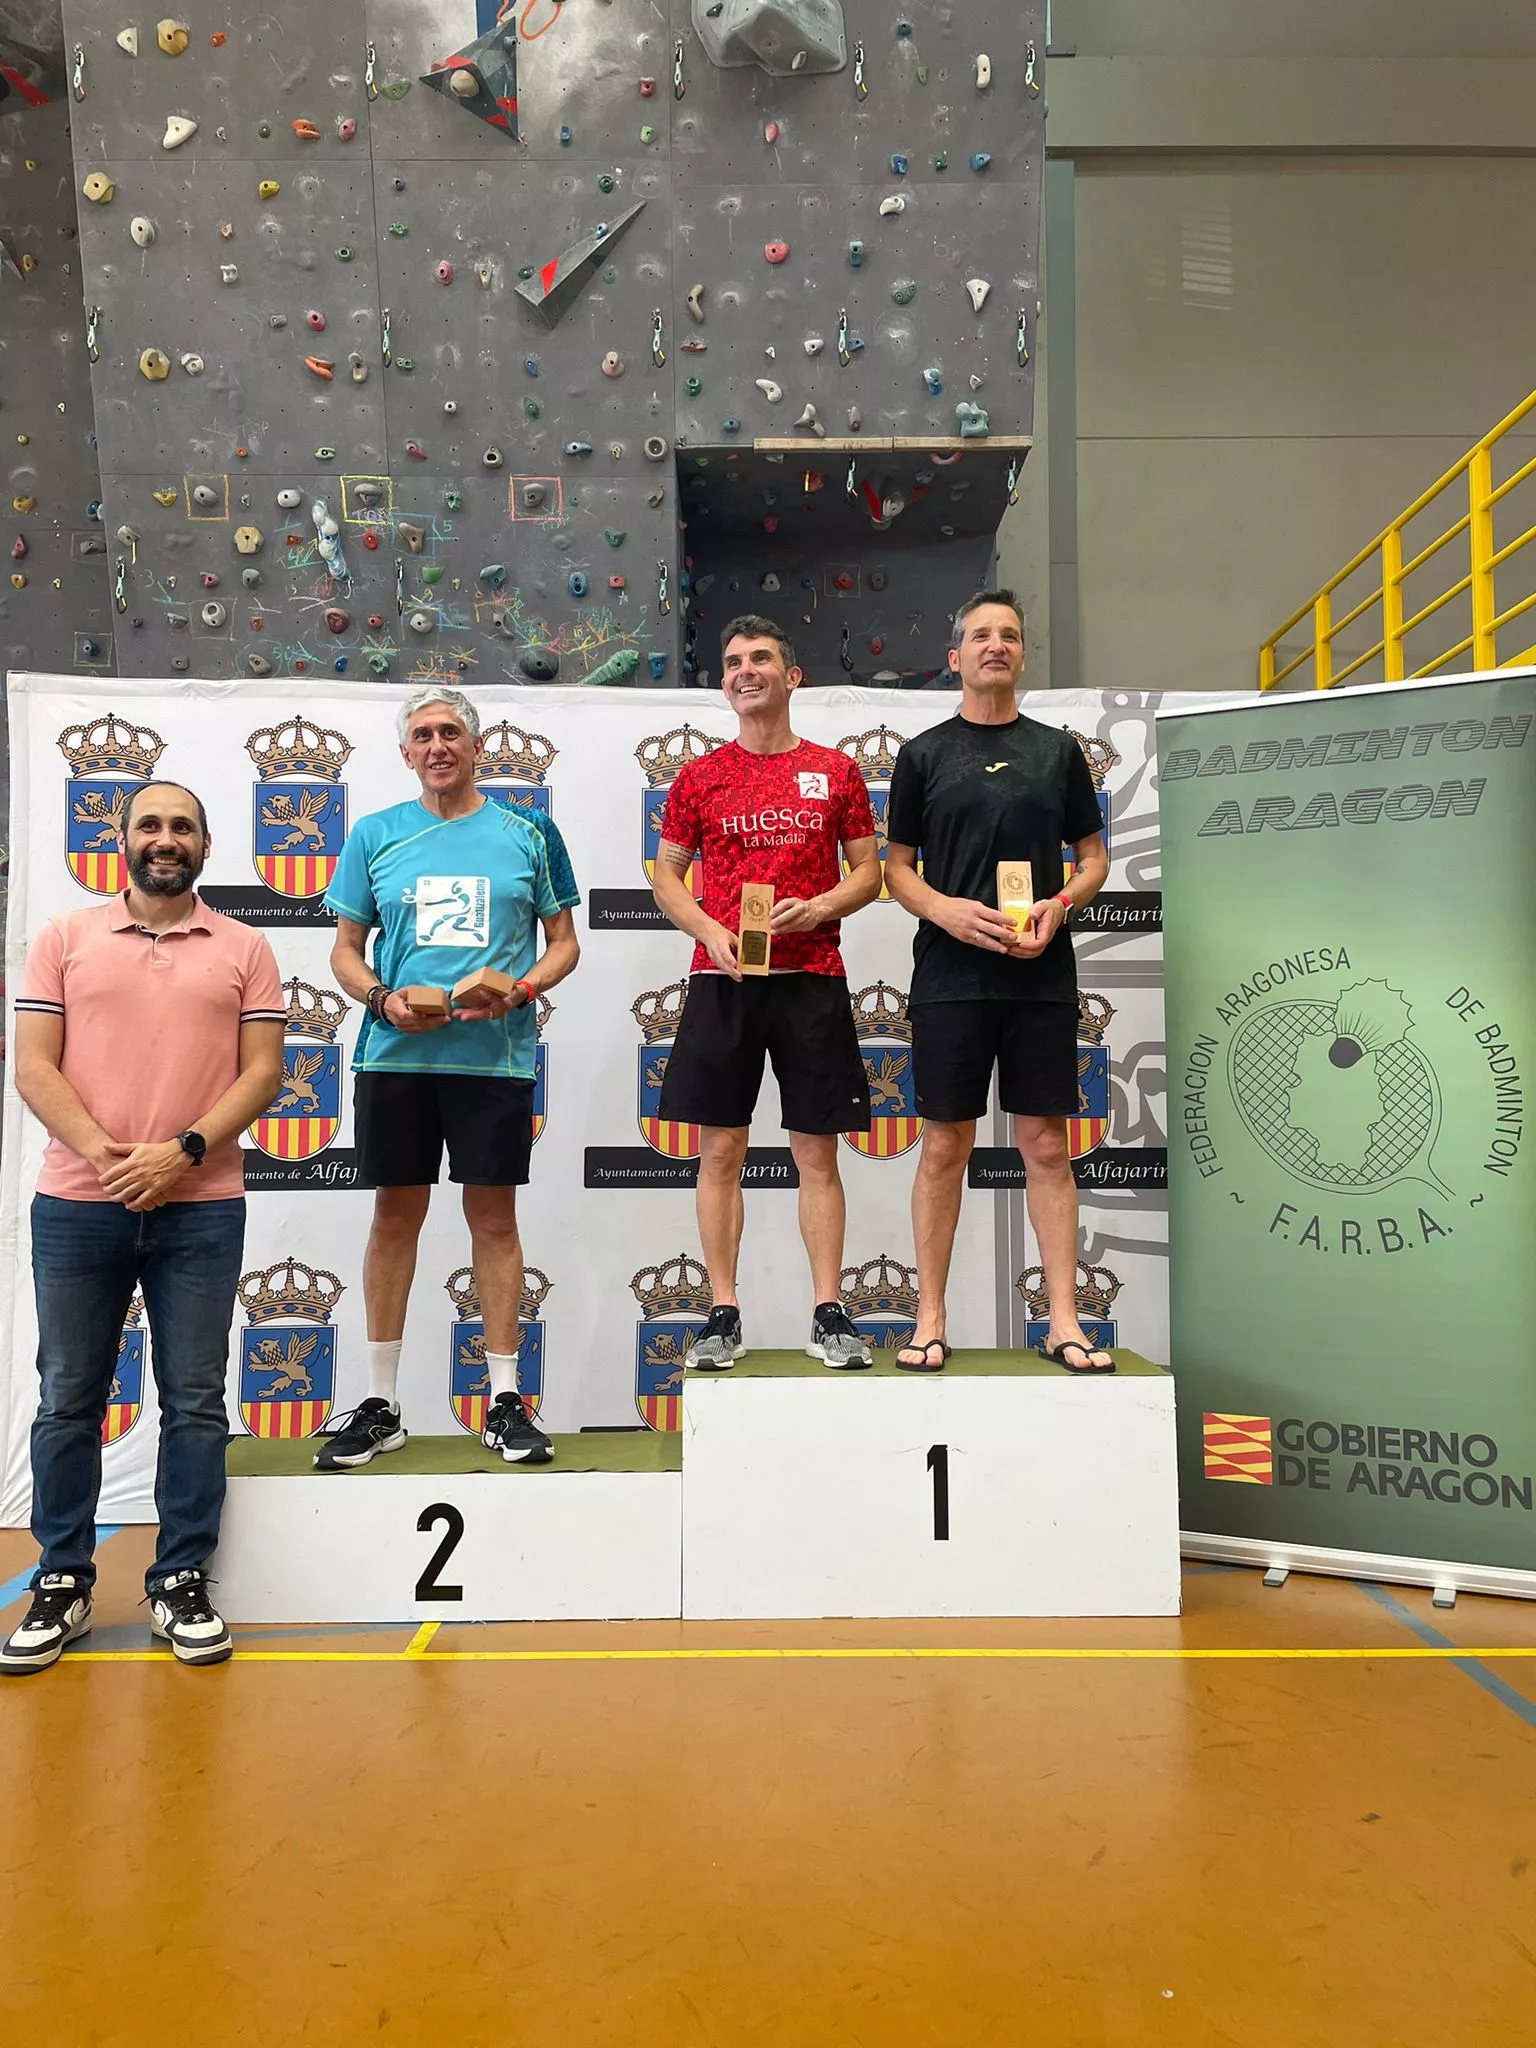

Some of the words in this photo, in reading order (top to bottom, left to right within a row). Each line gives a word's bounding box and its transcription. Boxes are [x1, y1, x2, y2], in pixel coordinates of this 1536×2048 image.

[443, 520, 453, 532] 5
[1161, 714, 1533, 782] BADMINTON
[1198, 778, 1487, 837] ARAGON
[294, 905, 309, 917] de
[598, 909, 668, 922] Ayuntamien
[1184, 1034, 1224, 1179] FEDERACION
[1216, 947, 1351, 1026] ARAGONESA
[1445, 986, 1485, 1022] DE
[1475, 1024, 1523, 1176] BADMINTON
[287, 1169, 301, 1180] de
[593, 1168, 676, 1180] Ayuntamiento
[678, 1168, 692, 1178] de
[1277, 1418, 1498, 1468] GOBIERNO
[926, 1444, 950, 1541] 1
[1278, 1455, 1331, 1490] DE
[1346, 1461, 1533, 1510] ARAGON
[415, 1502, 465, 1601] 2
